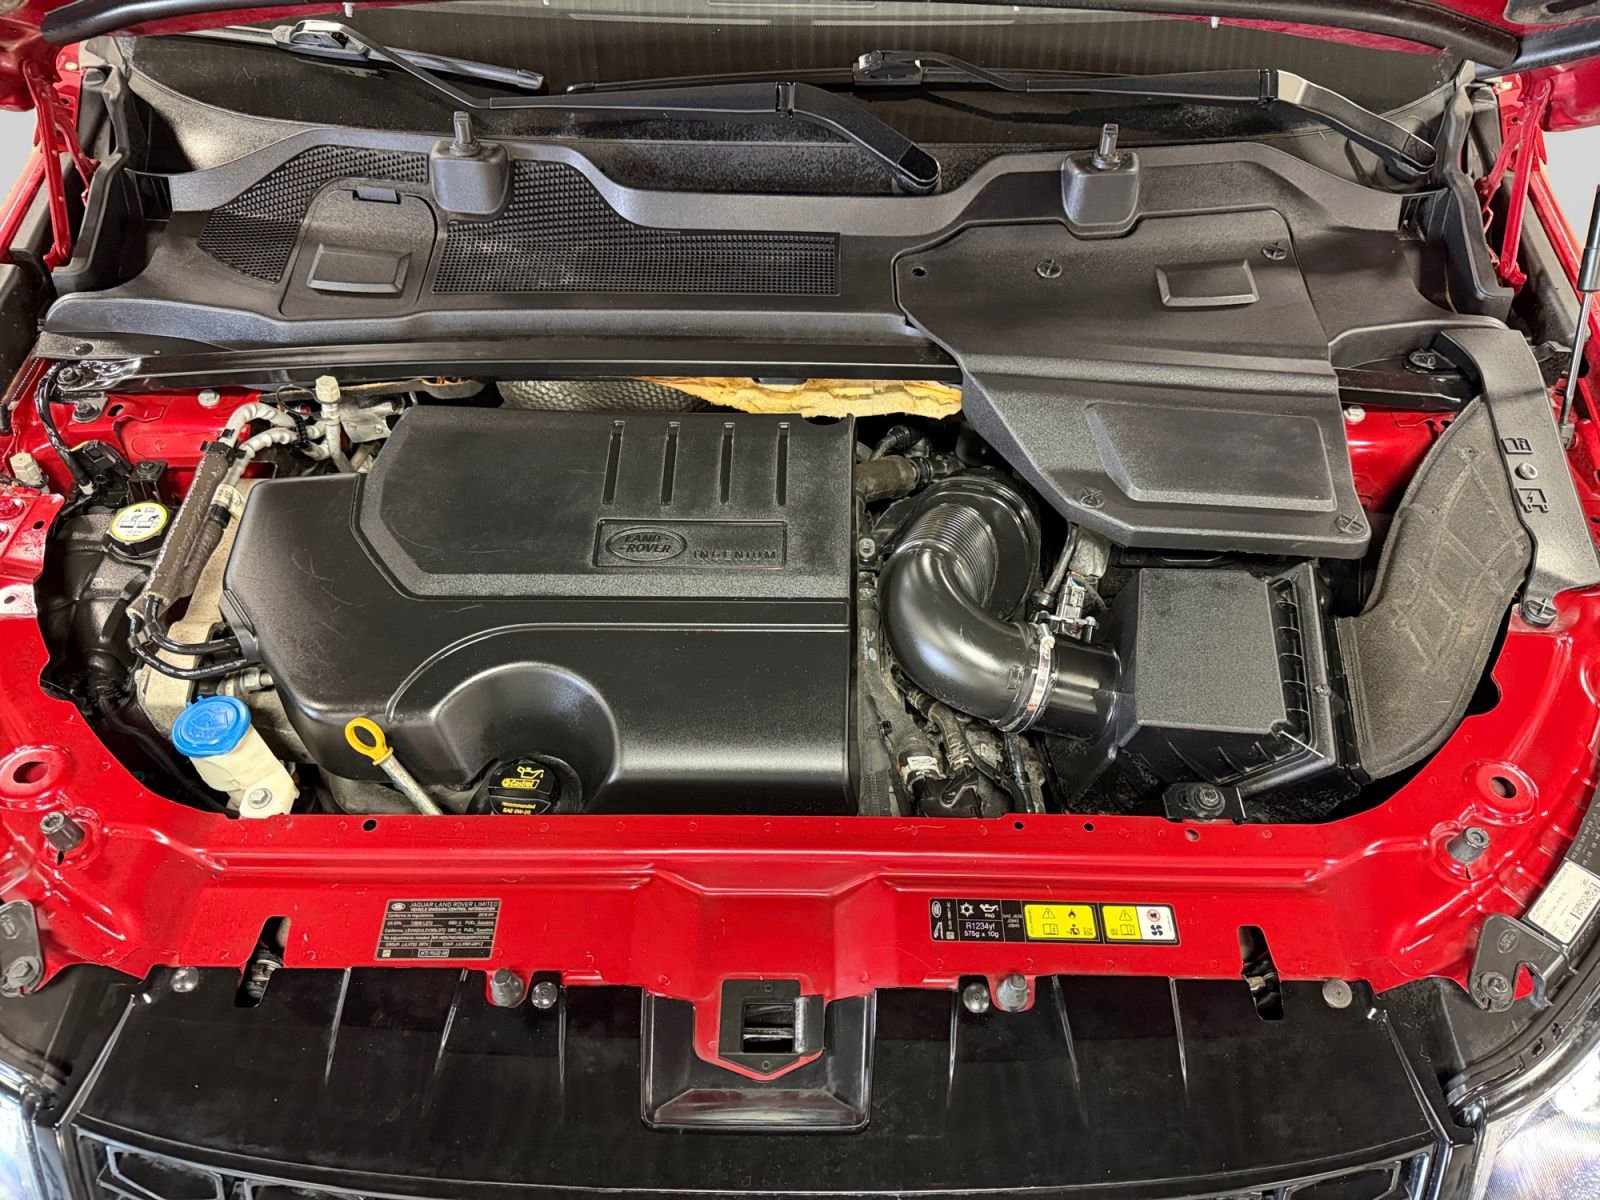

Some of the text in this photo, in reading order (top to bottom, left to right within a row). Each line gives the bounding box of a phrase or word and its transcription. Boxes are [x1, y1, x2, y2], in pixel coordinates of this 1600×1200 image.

[624, 534, 661, 543] LAND
[625, 543, 672, 553] ROVER
[693, 550, 776, 559] INGENIUM
[965, 922, 996, 931] R1234yf
